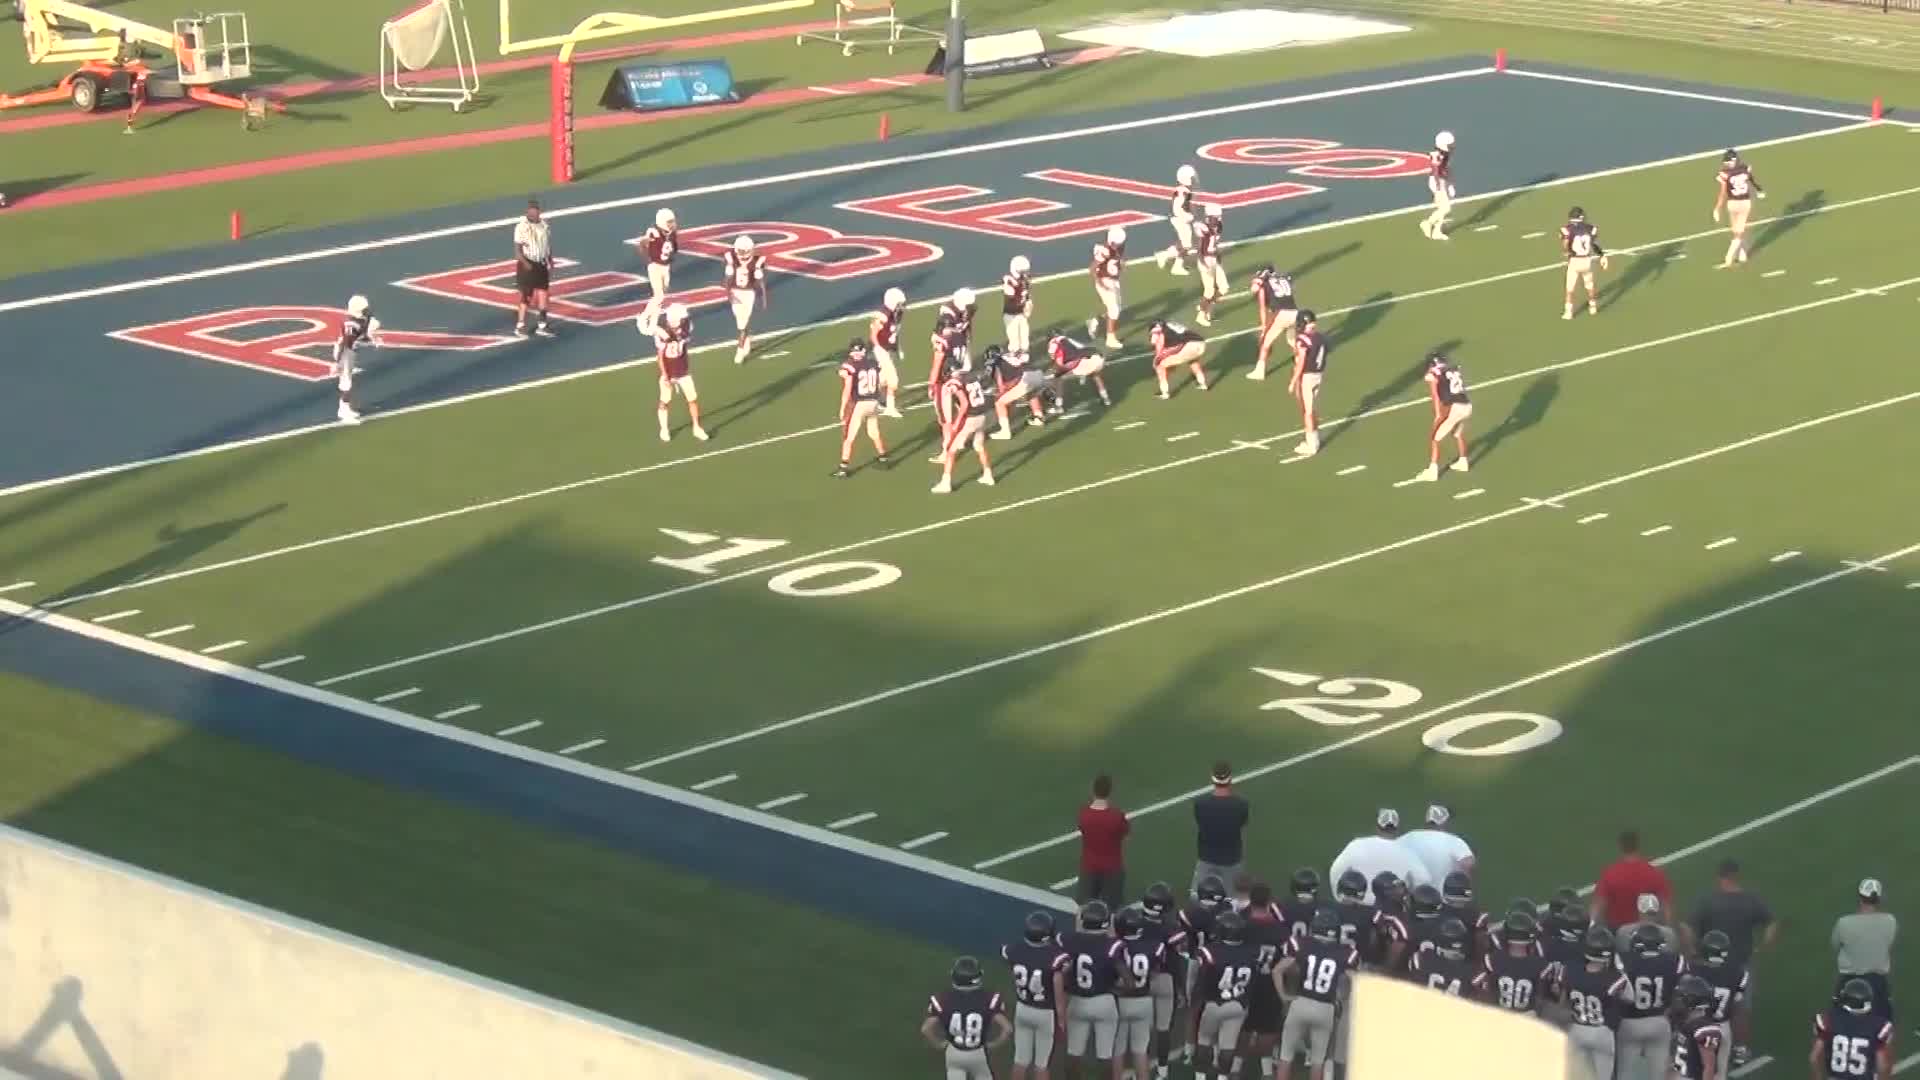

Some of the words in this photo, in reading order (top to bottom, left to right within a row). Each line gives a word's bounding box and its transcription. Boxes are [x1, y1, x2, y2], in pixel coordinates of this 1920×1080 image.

[857, 367, 878, 396] 20
[1012, 963, 1046, 1001] 24
[1075, 952, 1094, 990] 6
[1217, 965, 1252, 1000] 42
[1303, 953, 1338, 994] 18
[1634, 976, 1665, 1010] 61
[948, 1012, 983, 1049] 48
[1830, 1034, 1870, 1076] 85
